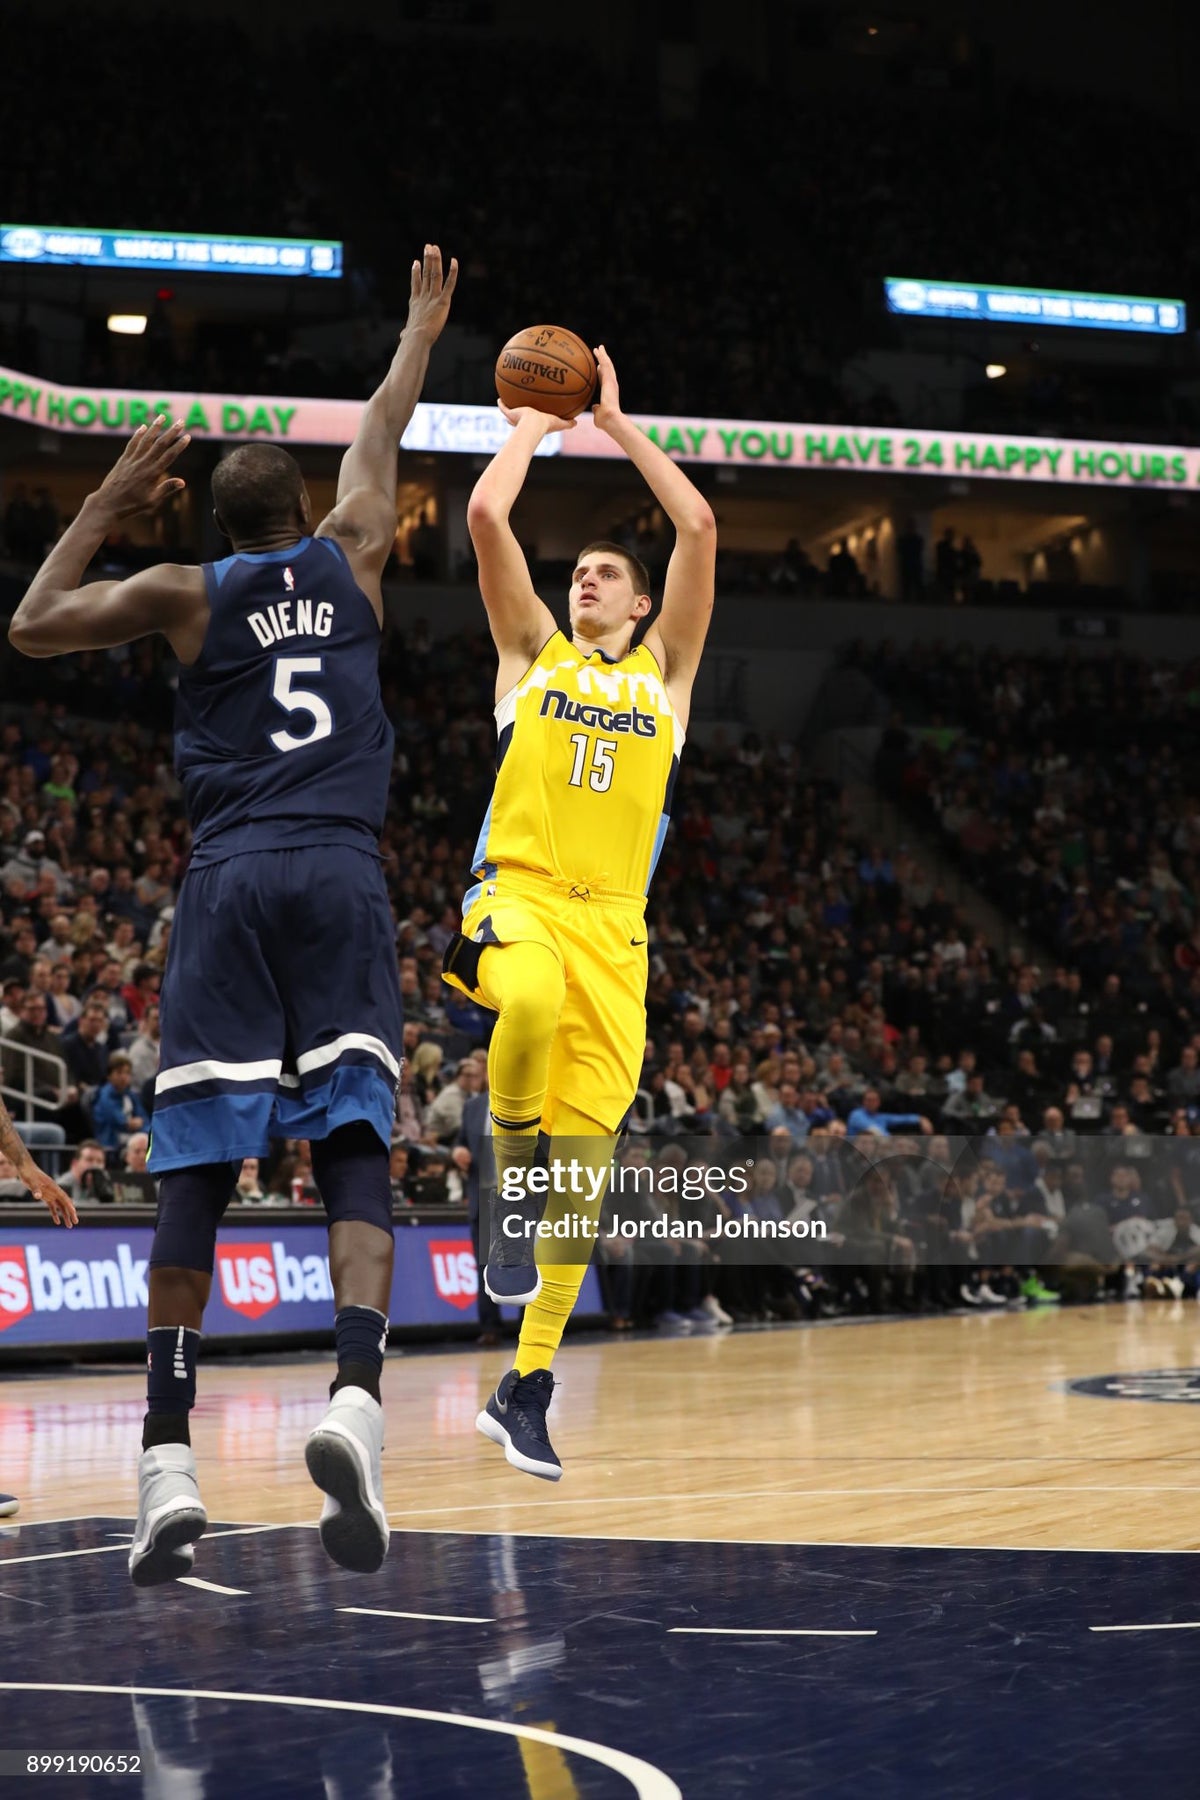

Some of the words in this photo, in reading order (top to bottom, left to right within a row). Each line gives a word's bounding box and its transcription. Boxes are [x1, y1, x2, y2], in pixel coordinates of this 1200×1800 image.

[502, 352, 568, 385] SPALDING
[48, 391, 172, 432] HOURS
[185, 402, 209, 432] A
[221, 403, 295, 435] DAY
[718, 427, 793, 460] YOU
[805, 432, 893, 466] HAVE
[903, 437, 944, 468] 24
[955, 442, 1063, 475] HAPPY
[1073, 450, 1188, 482] HOURS
[247, 600, 334, 648] DIENG
[269, 656, 333, 753] 5
[568, 733, 618, 793] 15
